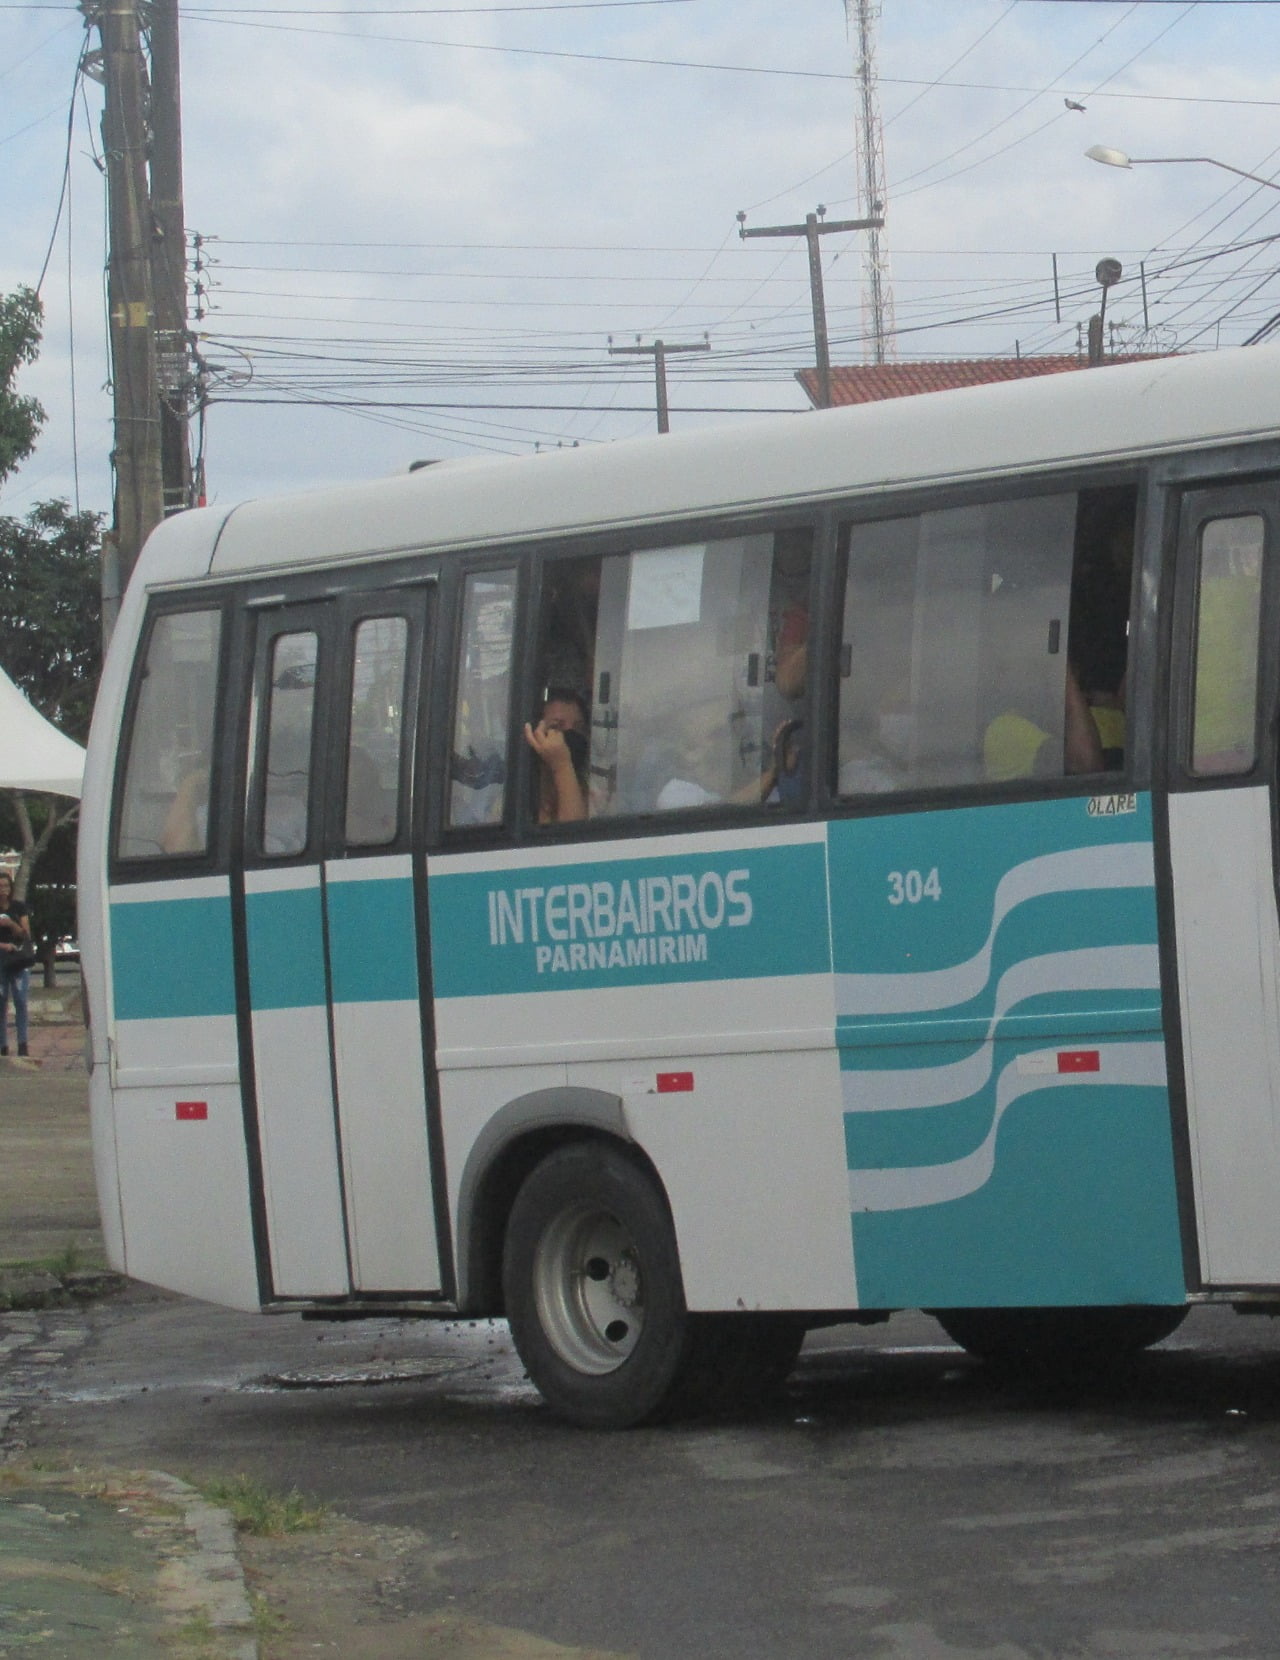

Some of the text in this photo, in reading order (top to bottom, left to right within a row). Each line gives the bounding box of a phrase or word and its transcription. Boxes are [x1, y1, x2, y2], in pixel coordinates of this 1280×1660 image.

[488, 868, 753, 945] INTERBAIRROS
[887, 867, 942, 905] 304
[536, 933, 708, 974] PARNAMIRIM
